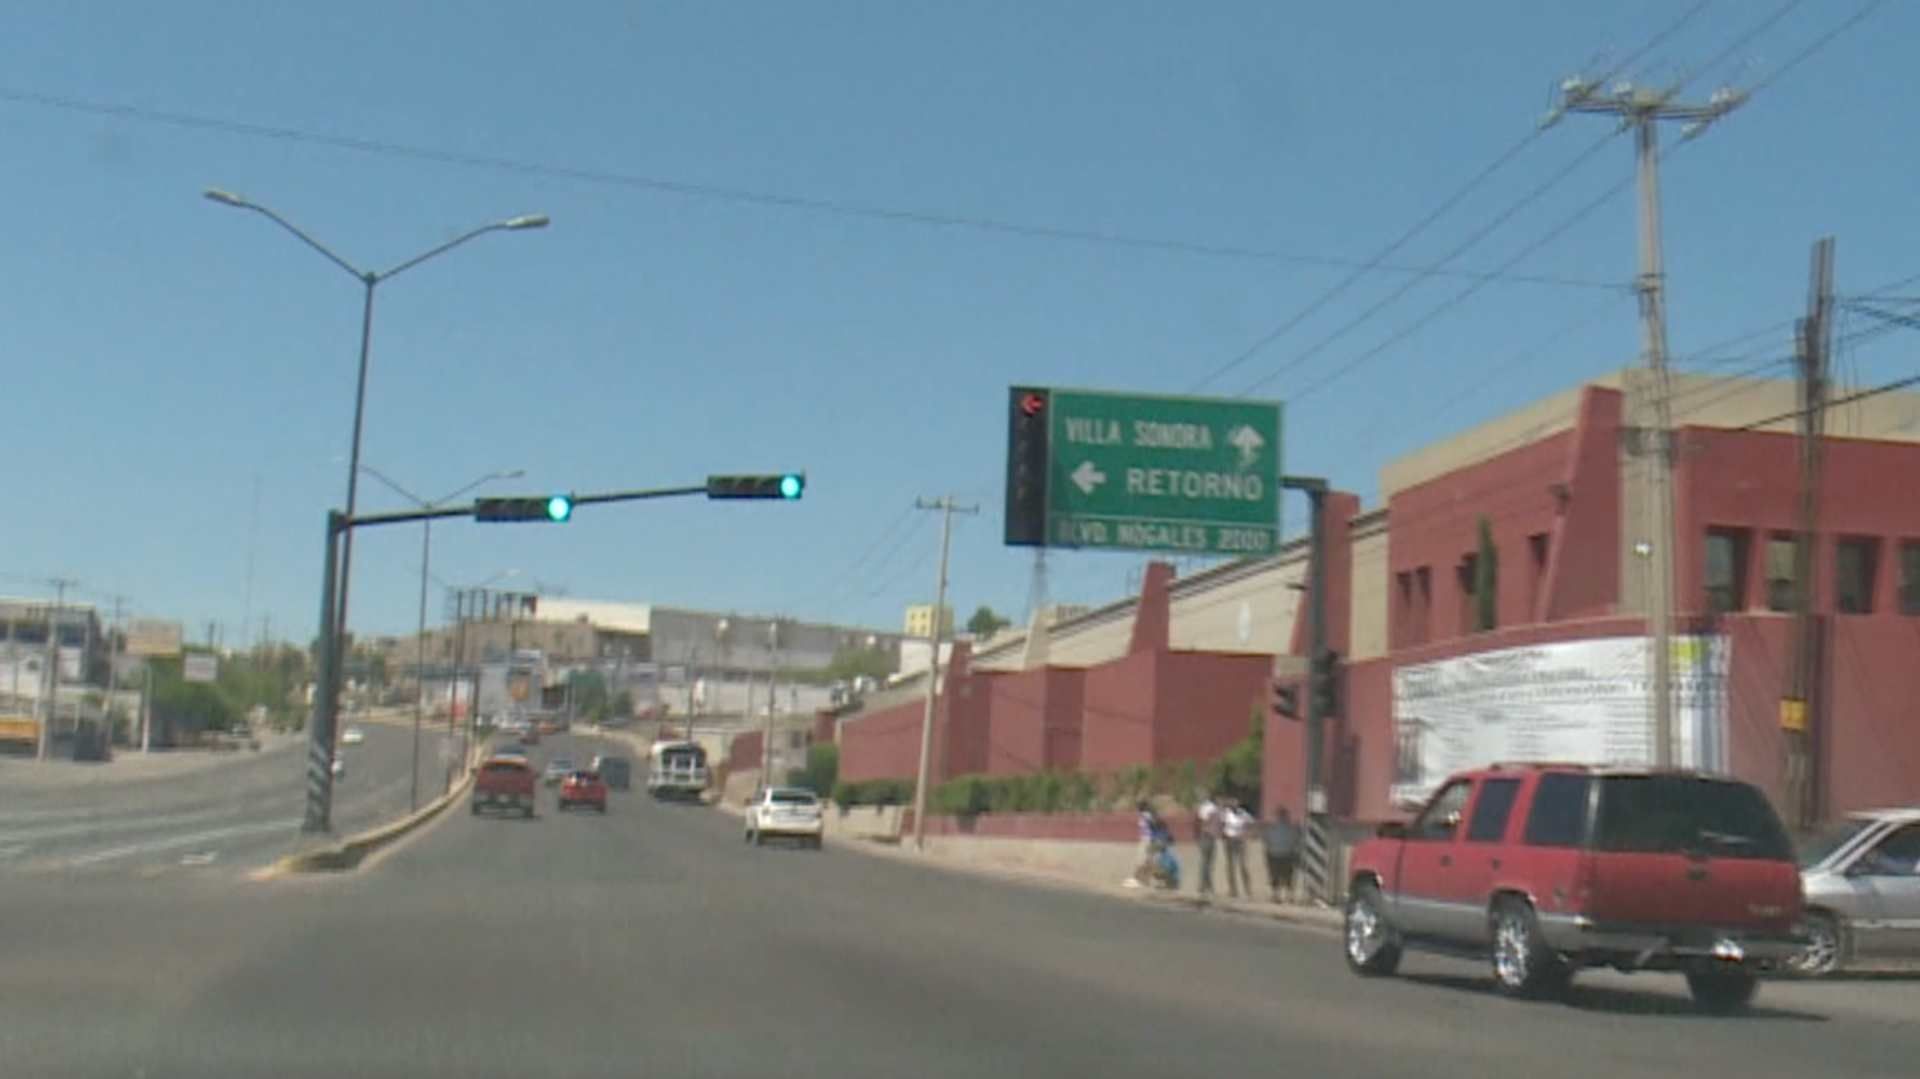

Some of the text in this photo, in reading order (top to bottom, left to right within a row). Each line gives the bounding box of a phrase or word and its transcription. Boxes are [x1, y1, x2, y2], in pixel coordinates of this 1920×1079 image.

[1065, 416, 1212, 449] VILLA SONORA
[1127, 468, 1263, 501] RETORNO
